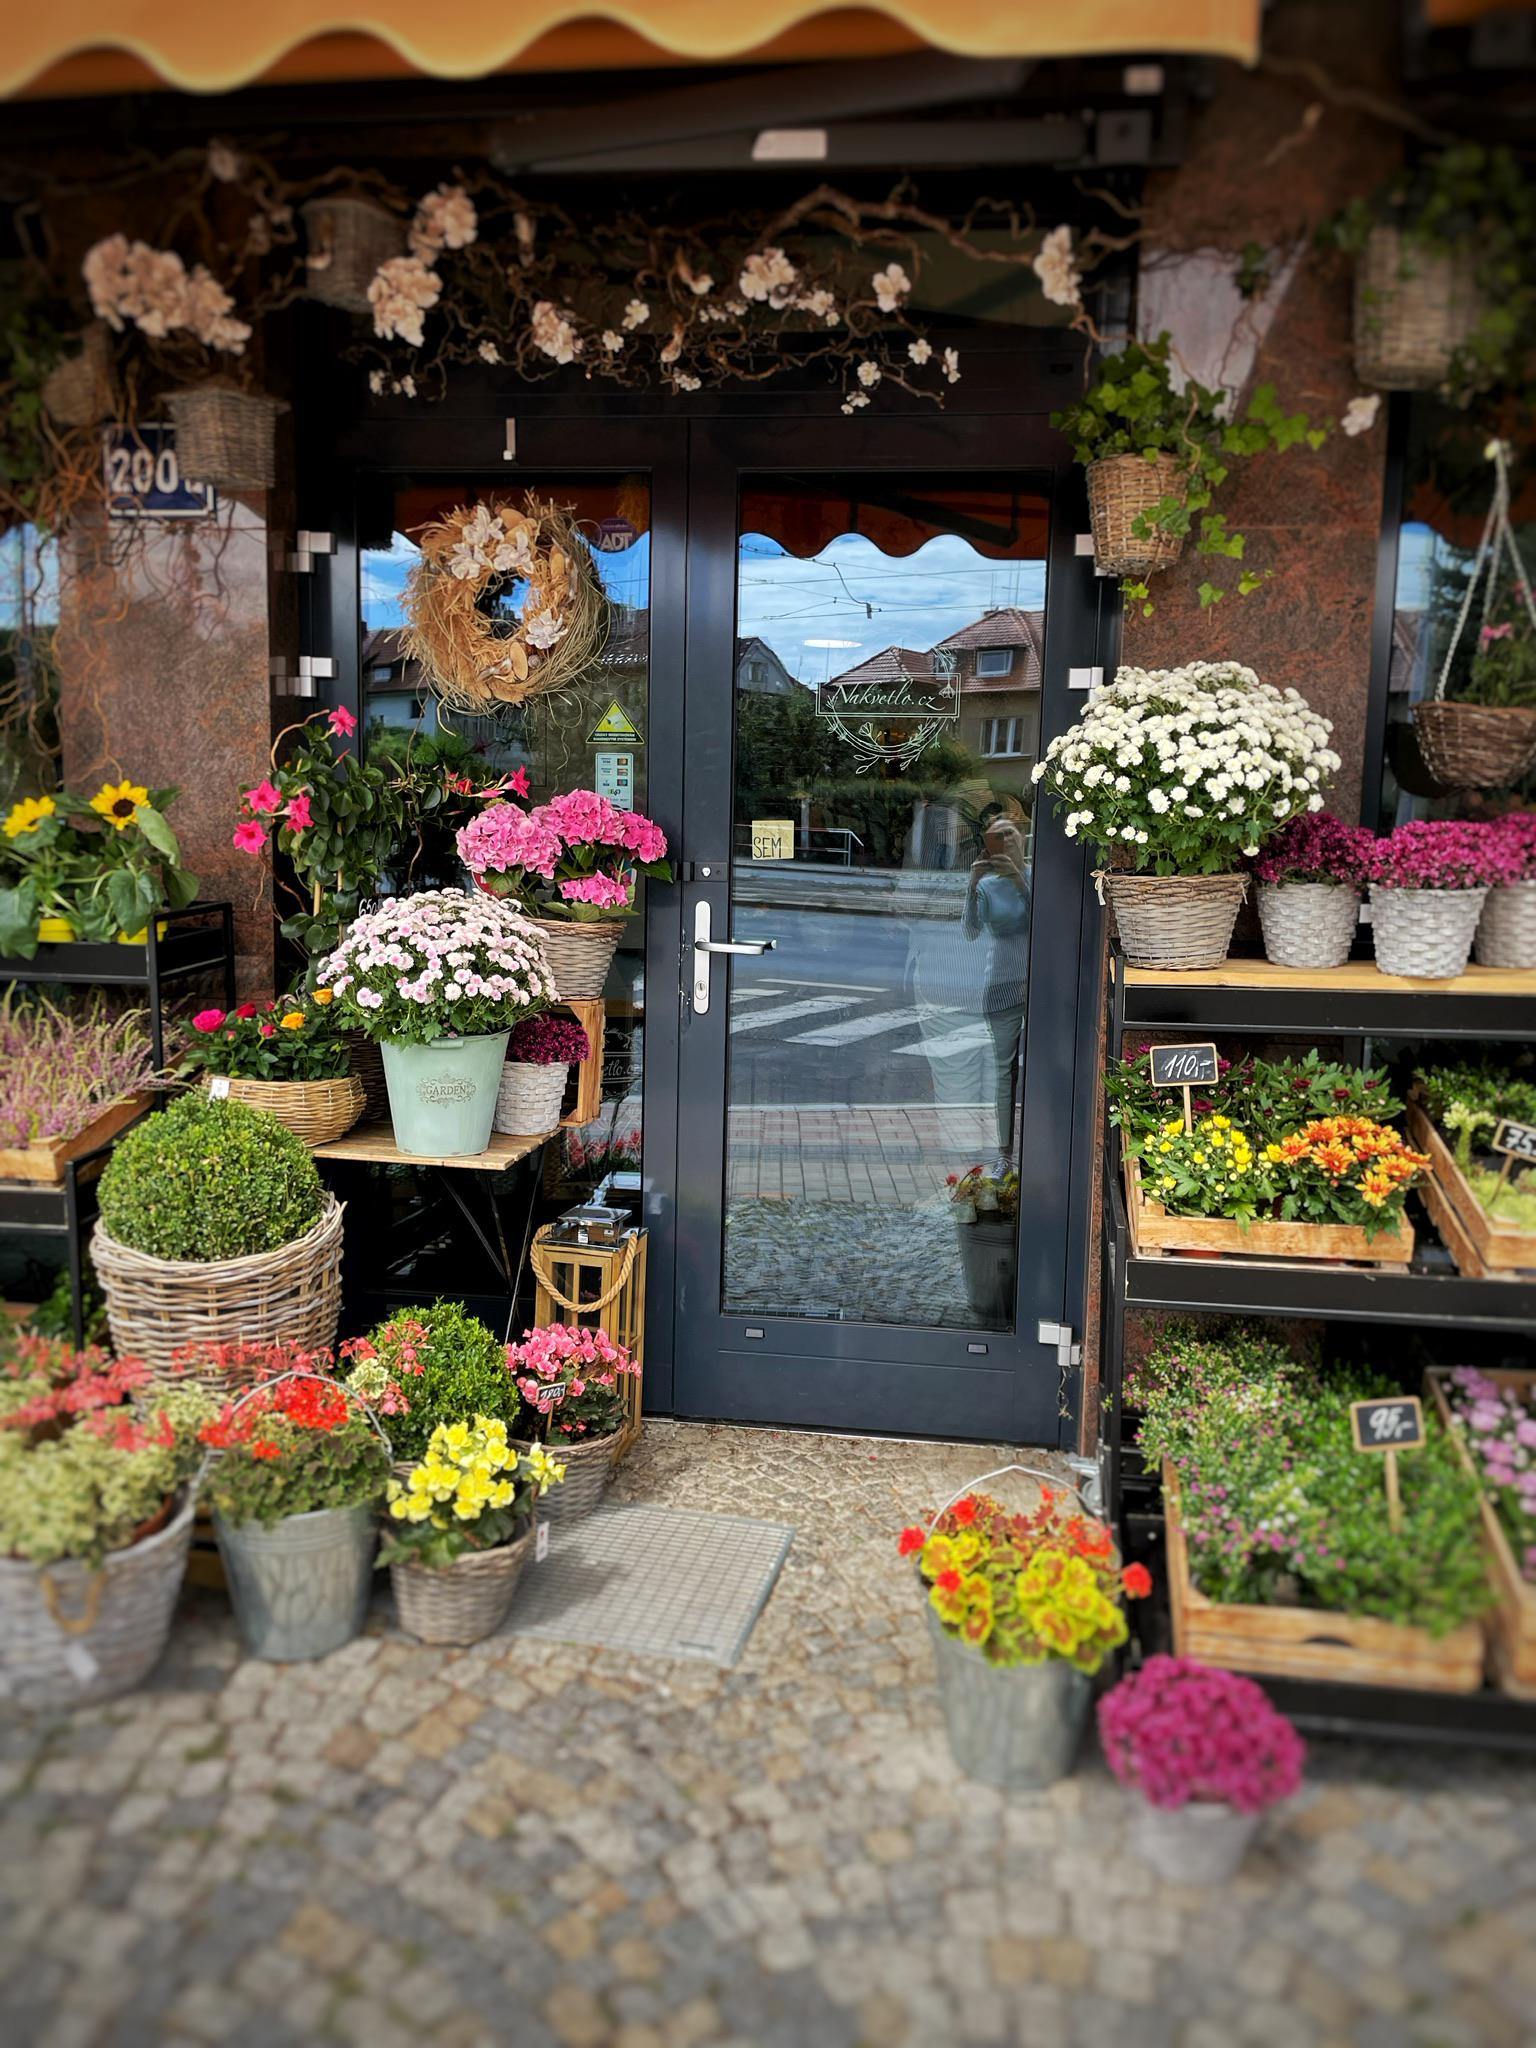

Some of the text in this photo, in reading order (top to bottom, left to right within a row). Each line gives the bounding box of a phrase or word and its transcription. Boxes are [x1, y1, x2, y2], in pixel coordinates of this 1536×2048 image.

[111, 449, 203, 494] 200
[601, 533, 633, 550] ADT
[835, 678, 946, 711] Nakvetlo.cz
[753, 836, 782, 859] SEM
[425, 1085, 466, 1097] GARDEN
